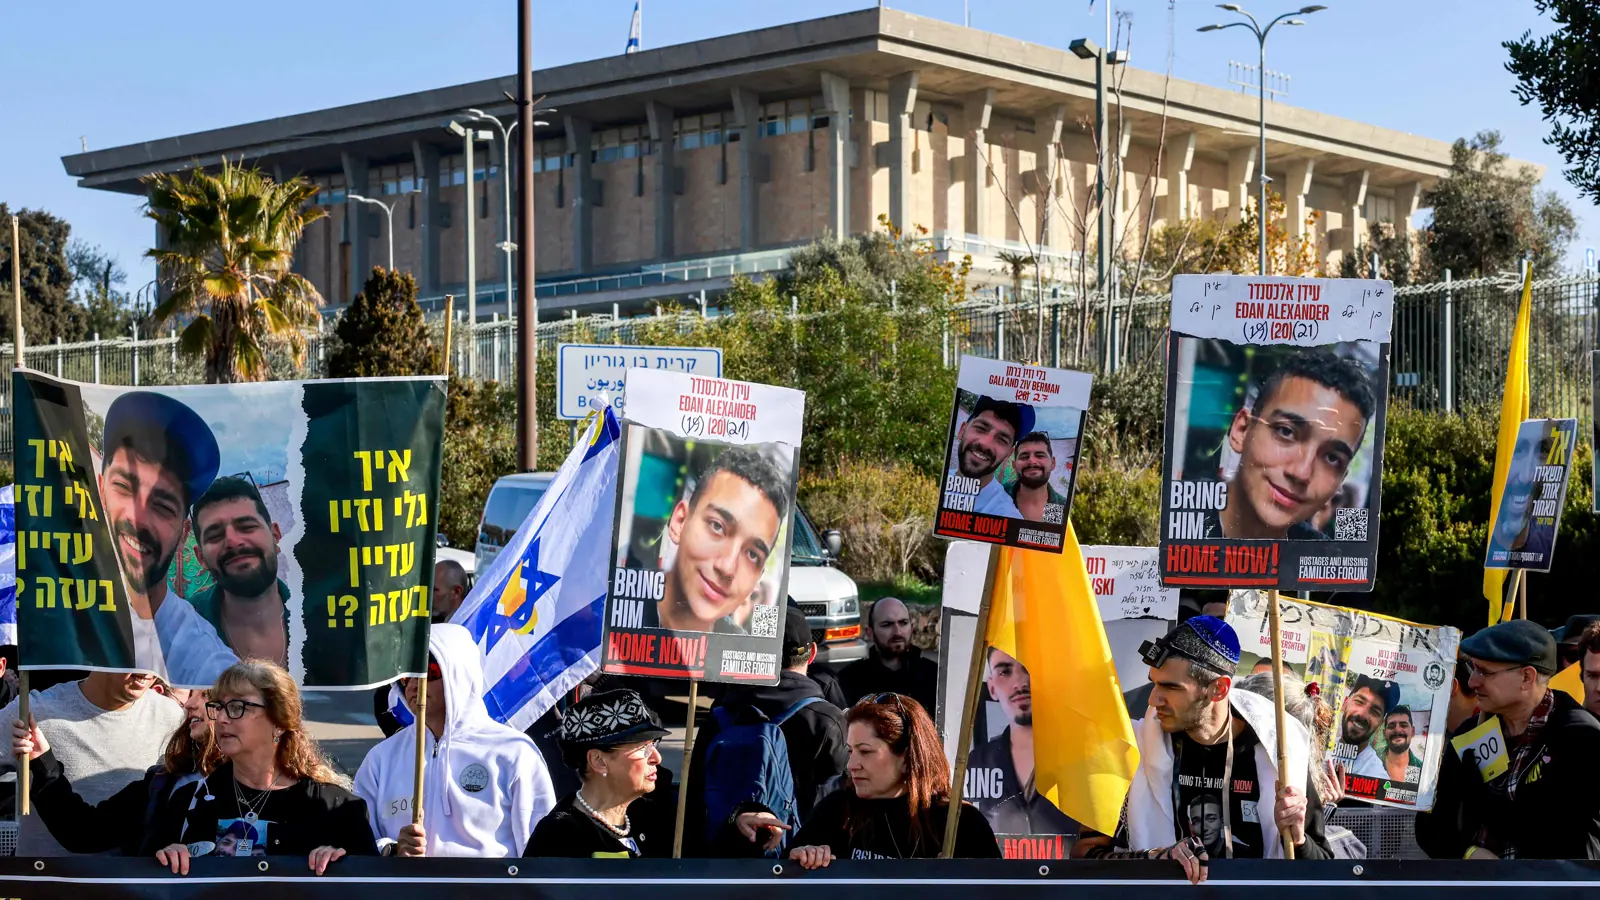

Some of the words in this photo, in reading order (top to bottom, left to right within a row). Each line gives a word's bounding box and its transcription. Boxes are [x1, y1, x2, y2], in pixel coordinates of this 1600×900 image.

[1248, 283, 1294, 300] אלכסנדר
[1298, 285, 1320, 302] עידן
[1235, 302, 1264, 319] EDAN
[1267, 303, 1330, 320] ALEXANDER
[585, 355, 625, 370] גוריון
[656, 357, 697, 372] קרית
[690, 377, 729, 398] אלכסנדר
[731, 383, 750, 401] עידן
[989, 375, 1005, 386] GALI
[1005, 377, 1019, 388] AND
[1020, 379, 1032, 390] ZIV
[1032, 381, 1061, 394] BERMAN
[679, 395, 704, 413] EDAN
[705, 398, 757, 420] ALEXANDER
[1546, 427, 1571, 465] אל
[28, 439, 75, 478] איך
[354, 449, 411, 491] איך
[946, 475, 981, 495] BRING
[1170, 481, 1227, 510] BRING
[1542, 482, 1560, 499] אותי
[15, 485, 53, 517] וזי
[65, 481, 98, 521] גלי
[394, 490, 428, 528] גלי
[943, 492, 976, 512] THEM
[1532, 500, 1556, 516] מאחור
[329, 498, 383, 532] וזיו
[939, 511, 973, 532] HOME
[974, 516, 1009, 537] NOW!
[1168, 512, 1204, 539] HIM
[1018, 533, 1041, 544] FAMILIES
[1041, 536, 1060, 546] FORUM
[17, 531, 93, 570] עדיין
[1166, 544, 1220, 573] HOME
[1224, 542, 1280, 575] NOW!
[349, 542, 415, 587] עדיין
[1299, 556, 1329, 566] HOSTAGES
[1329, 556, 1342, 566] AND
[1342, 557, 1368, 567] MISSING
[1298, 565, 1336, 579] FAMILIES
[1337, 566, 1368, 581] FORUM
[36, 577, 116, 611] בעזה
[613, 568, 665, 600] BRING
[369, 585, 429, 626] בעזה
[610, 599, 644, 628] HIM
[607, 632, 656, 664] HOME
[658, 635, 708, 668] NOW!
[722, 649, 747, 660] HOSTAGES
[746, 651, 757, 661] AND
[756, 653, 777, 662] MISSING
[721, 660, 752, 674] FAMILIES
[751, 662, 776, 676] FORUM
[1365, 656, 1378, 666] GALI
[1377, 659, 1388, 668] AND
[1388, 661, 1397, 669] ZIV
[1396, 662, 1418, 674] BERMAN
[1332, 743, 1359, 759] BRING
[963, 767, 1003, 798] RING
[1233, 779, 1253, 791] NOW
[1352, 777, 1379, 795] NOW!
